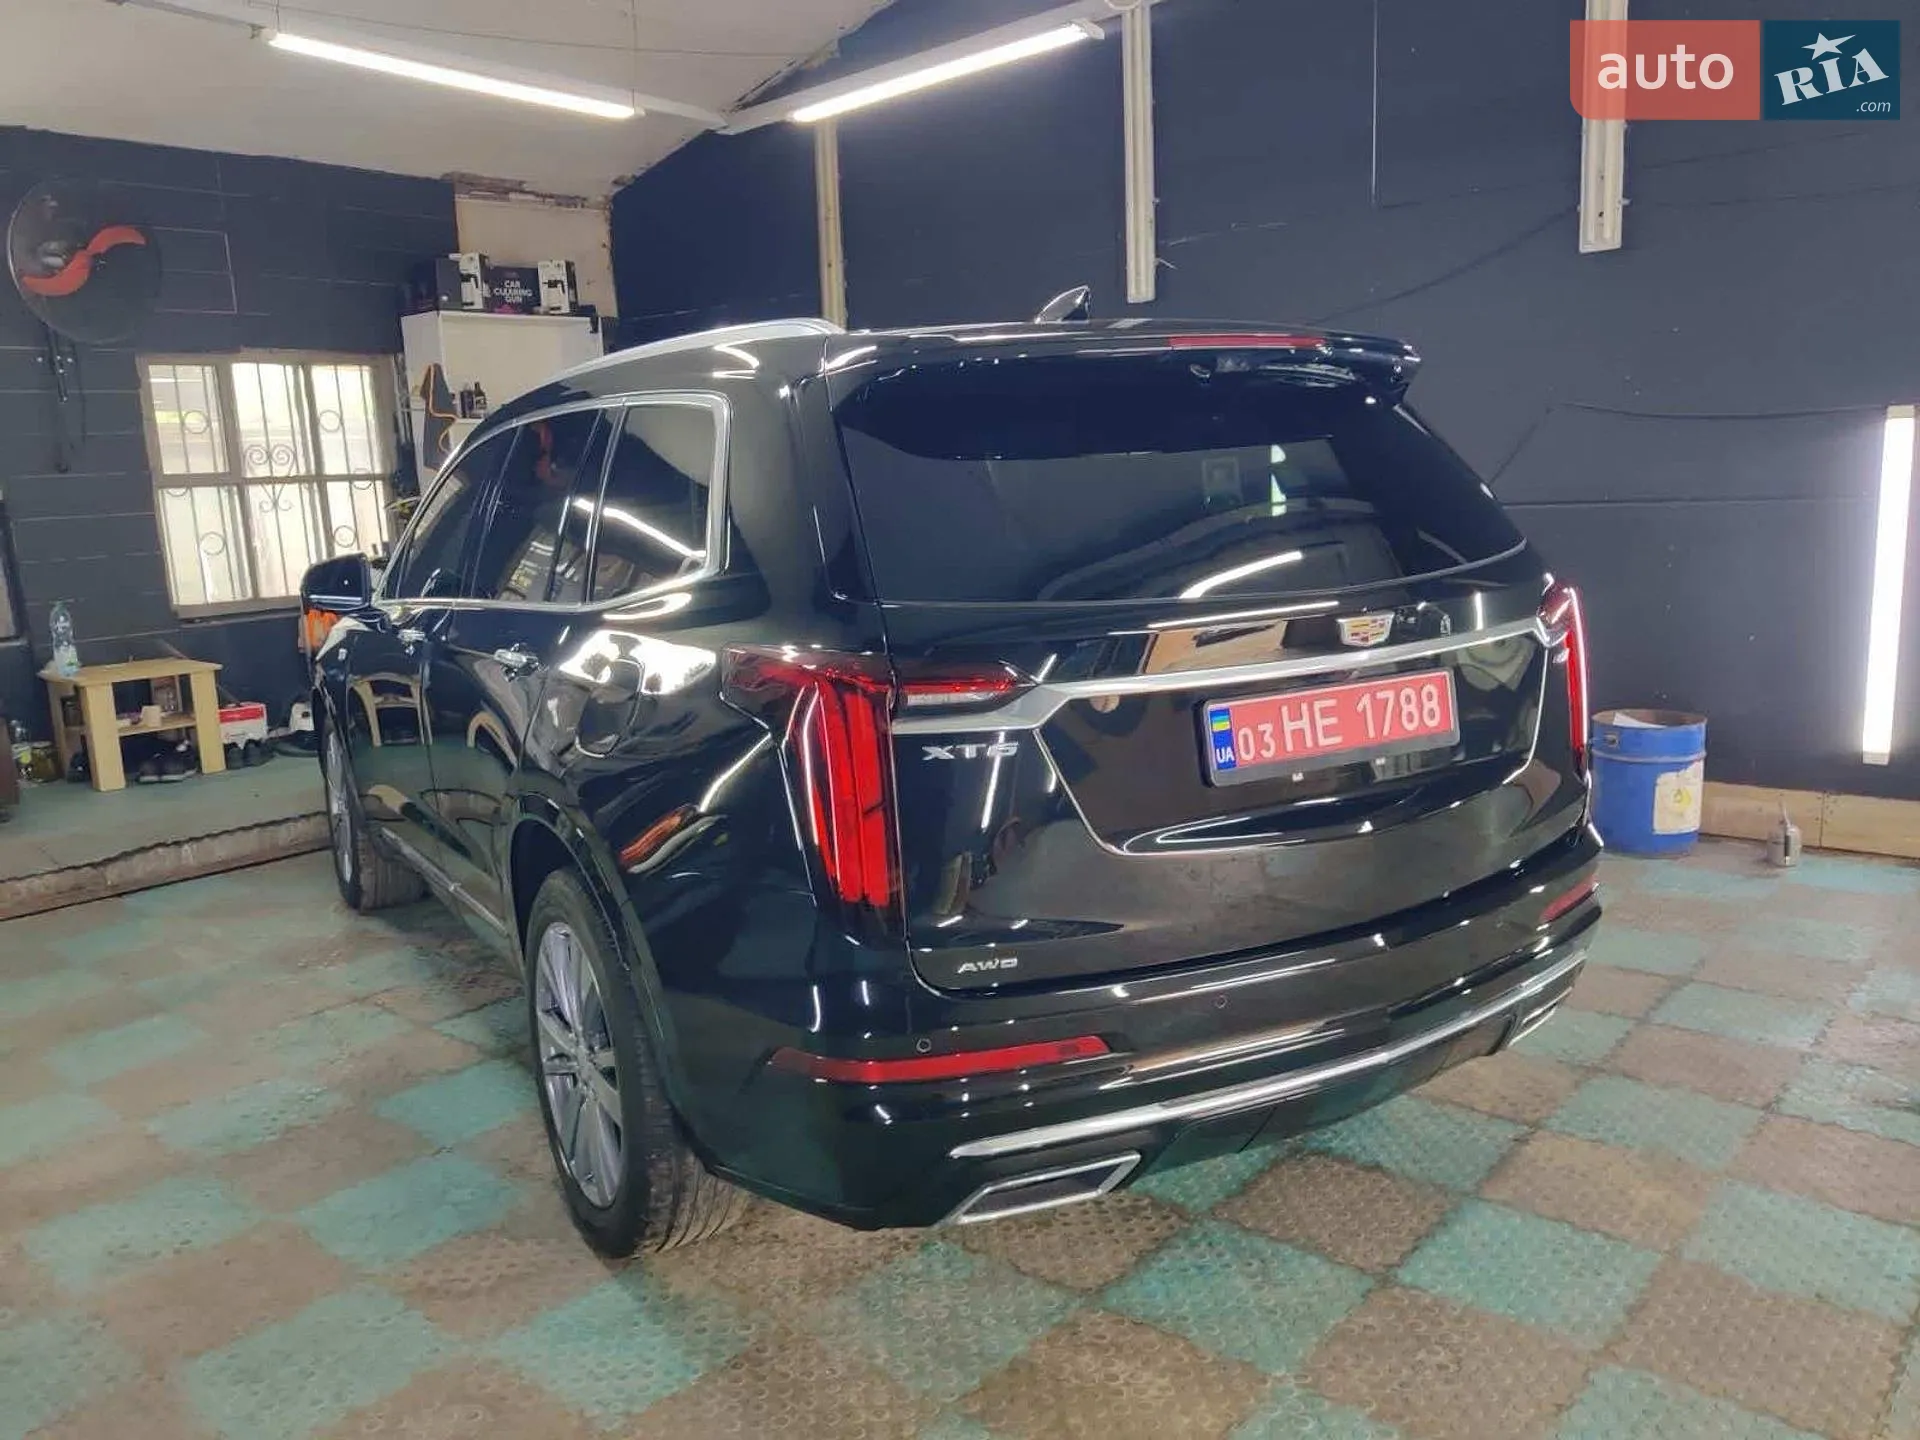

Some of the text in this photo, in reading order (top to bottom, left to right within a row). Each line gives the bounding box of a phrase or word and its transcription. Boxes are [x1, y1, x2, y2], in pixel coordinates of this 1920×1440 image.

[504, 280, 520, 288] CAR
[1356, 683, 1442, 739] 1788
[921, 742, 1019, 761] XT6
[1215, 746, 1235, 763] UA
[957, 957, 1018, 974] AWD
